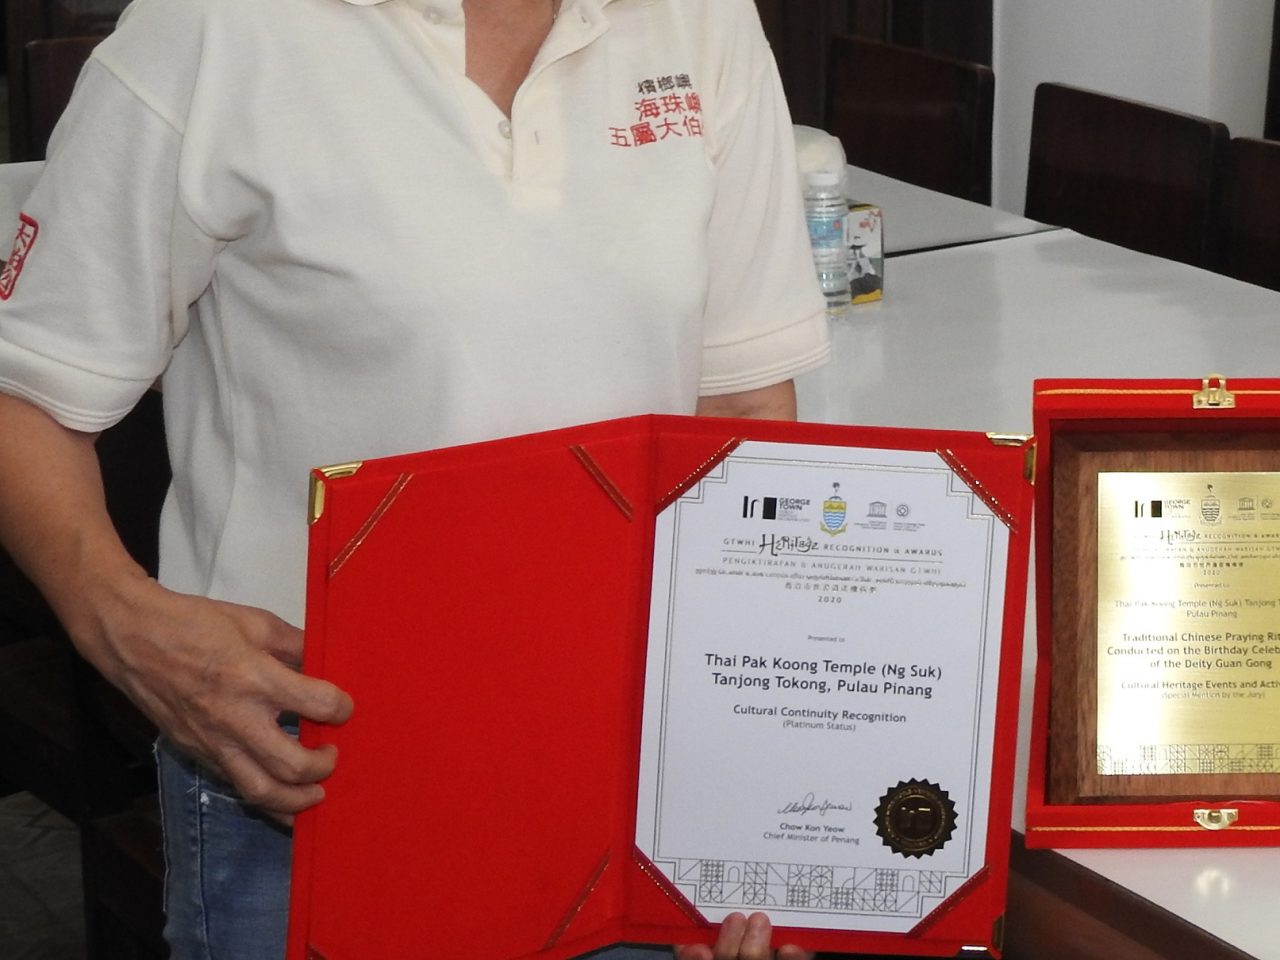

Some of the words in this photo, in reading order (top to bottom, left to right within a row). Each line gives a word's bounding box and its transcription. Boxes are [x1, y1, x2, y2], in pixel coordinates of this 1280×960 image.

[779, 497, 811, 506] GEORGE
[779, 503, 803, 511] TOWN
[818, 595, 843, 604] 2020
[1186, 610, 1209, 618] Pulau
[1210, 610, 1237, 619] Pinang
[1123, 633, 1177, 642] Traditional
[1181, 633, 1222, 642] Chinese
[1225, 633, 1264, 644] Praying
[1106, 646, 1163, 655] Conducted
[1183, 646, 1200, 655] the
[1204, 646, 1248, 657] Birthday
[705, 653, 736, 666] Thai
[742, 655, 767, 668] Pak
[772, 657, 818, 674] Koong
[822, 659, 876, 677] Temple
[881, 663, 905, 678] (Ng
[910, 664, 941, 680] Suk)
[1150, 660, 1159, 668] of
[1163, 660, 1181, 668] the
[1184, 660, 1212, 670] Deity
[1215, 660, 1242, 668] Guan
[1245, 660, 1272, 670] Gong
[713, 673, 770, 691] Tanjong
[775, 676, 831, 694] Tokong,
[837, 679, 878, 693] Pulau
[883, 681, 932, 699] Pinang
[1162, 681, 1203, 691] Heritage
[1205, 681, 1237, 689] Events
[1239, 681, 1257, 689] and
[733, 705, 777, 715] Cultural
[780, 707, 838, 720] Continuity
[841, 710, 906, 724] Recognition
[782, 720, 824, 730] (Platinum
[826, 723, 856, 732] Status)
[779, 823, 802, 831] Chow
[786, 833, 818, 842] Minister
[831, 836, 860, 846] Penang
